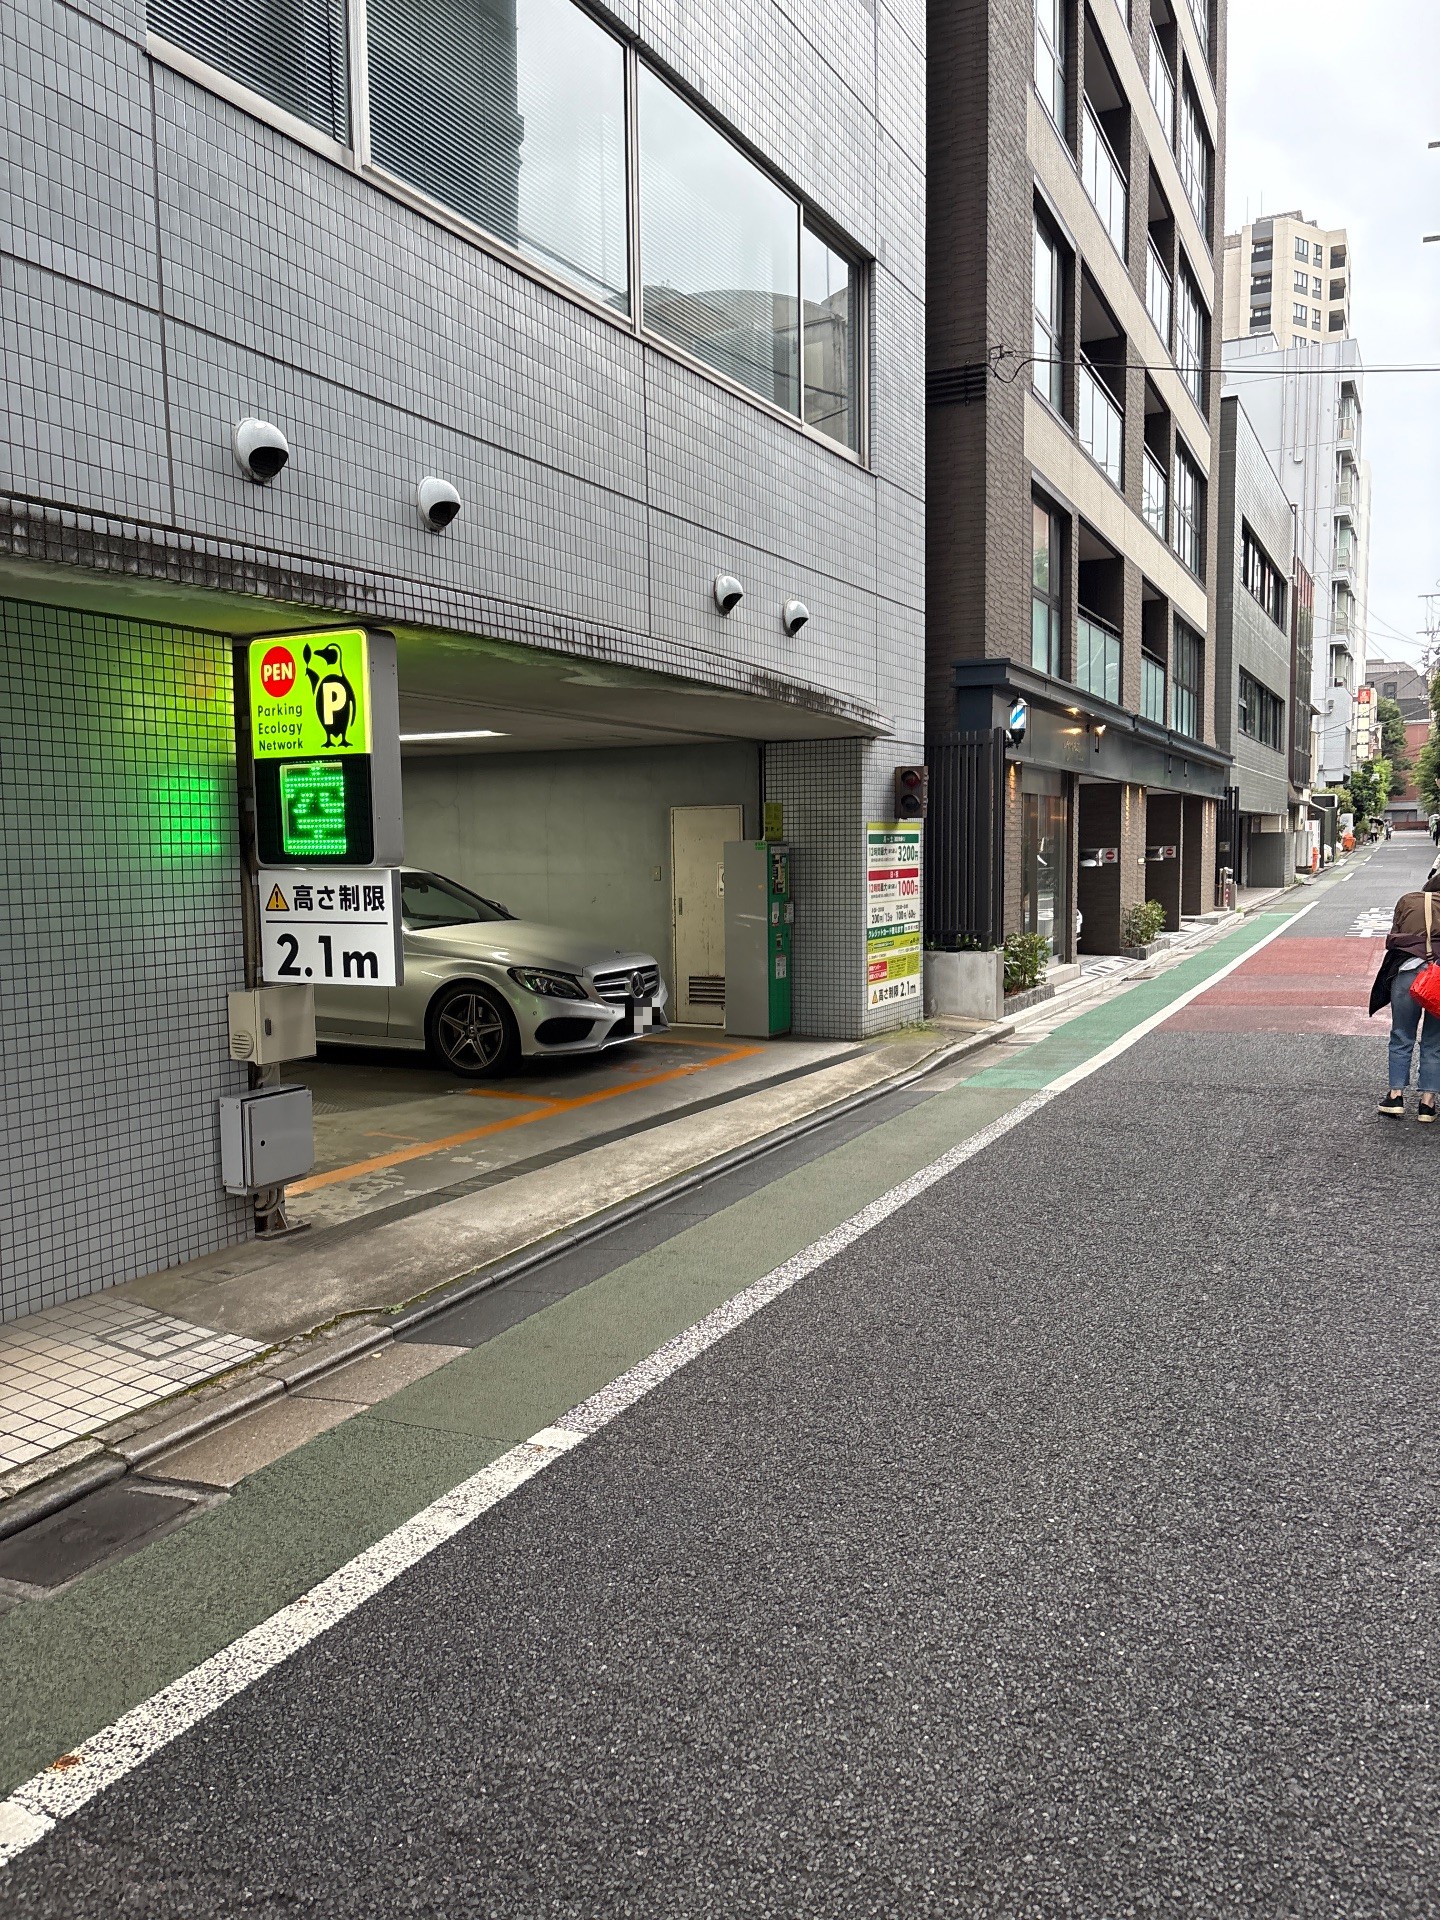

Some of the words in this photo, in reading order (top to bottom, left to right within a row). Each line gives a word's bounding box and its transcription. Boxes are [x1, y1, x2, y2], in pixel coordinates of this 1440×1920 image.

[263, 661, 294, 682] PEN
[257, 703, 304, 718] Parking
[322, 682, 347, 725] P
[258, 720, 304, 737] Ecology
[258, 737, 304, 752] Network
[897, 845, 919, 862] 3200円
[292, 884, 386, 912] 高さ制限
[898, 880, 919, 897] 1000円
[276, 933, 380, 979] 2.1m
[878, 985, 899, 1002] 高さ制限
[900, 981, 917, 997] 2.1m
